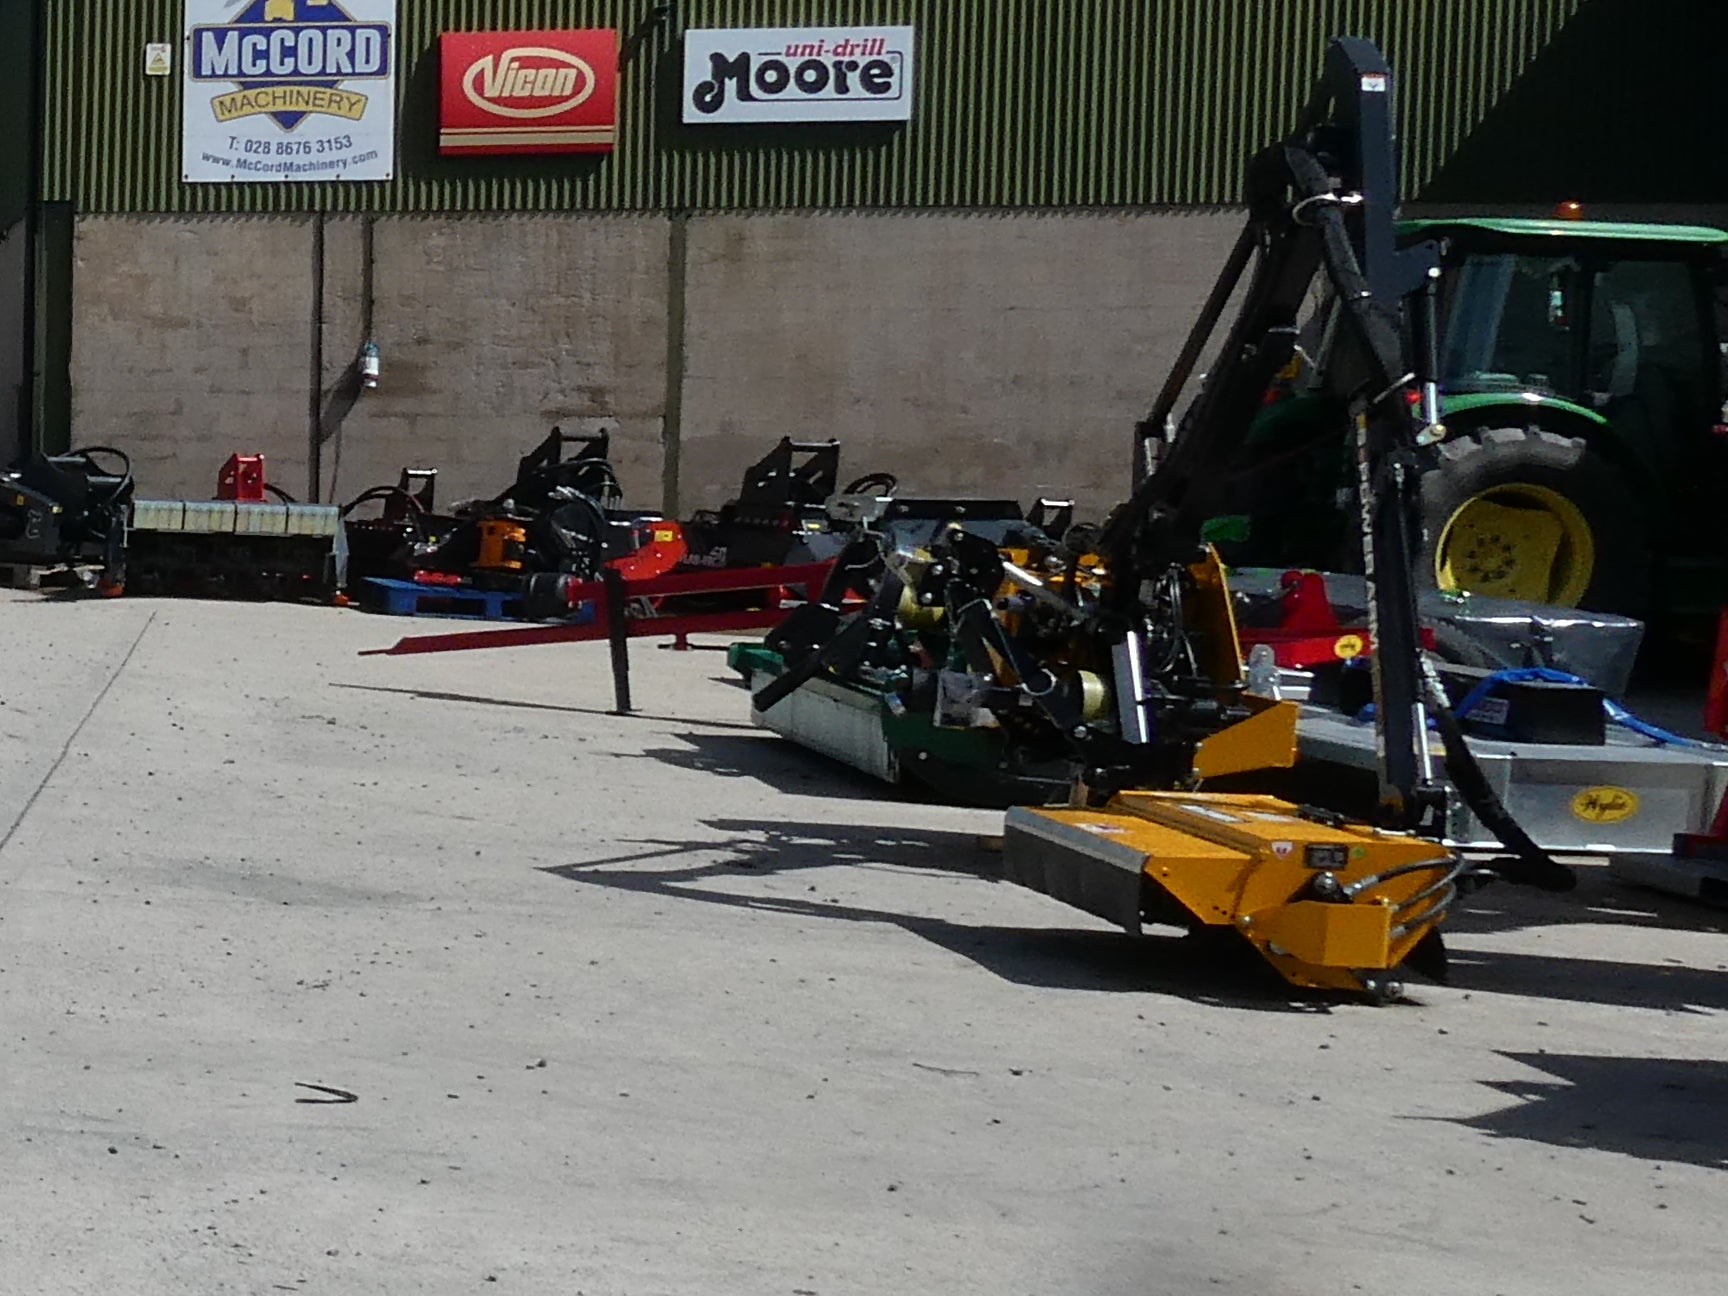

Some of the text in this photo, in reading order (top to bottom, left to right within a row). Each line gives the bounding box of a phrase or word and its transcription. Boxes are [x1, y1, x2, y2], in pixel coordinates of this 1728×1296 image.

[200, 28, 381, 76] McCORD
[785, 38, 885, 57] uni-drill
[482, 54, 578, 98] Vicon
[693, 51, 895, 114] Moore
[218, 89, 363, 116] MACHINERY
[228, 134, 352, 155] T: 028 8676 3153
[201, 150, 378, 173] www.McCordMachinery.com
